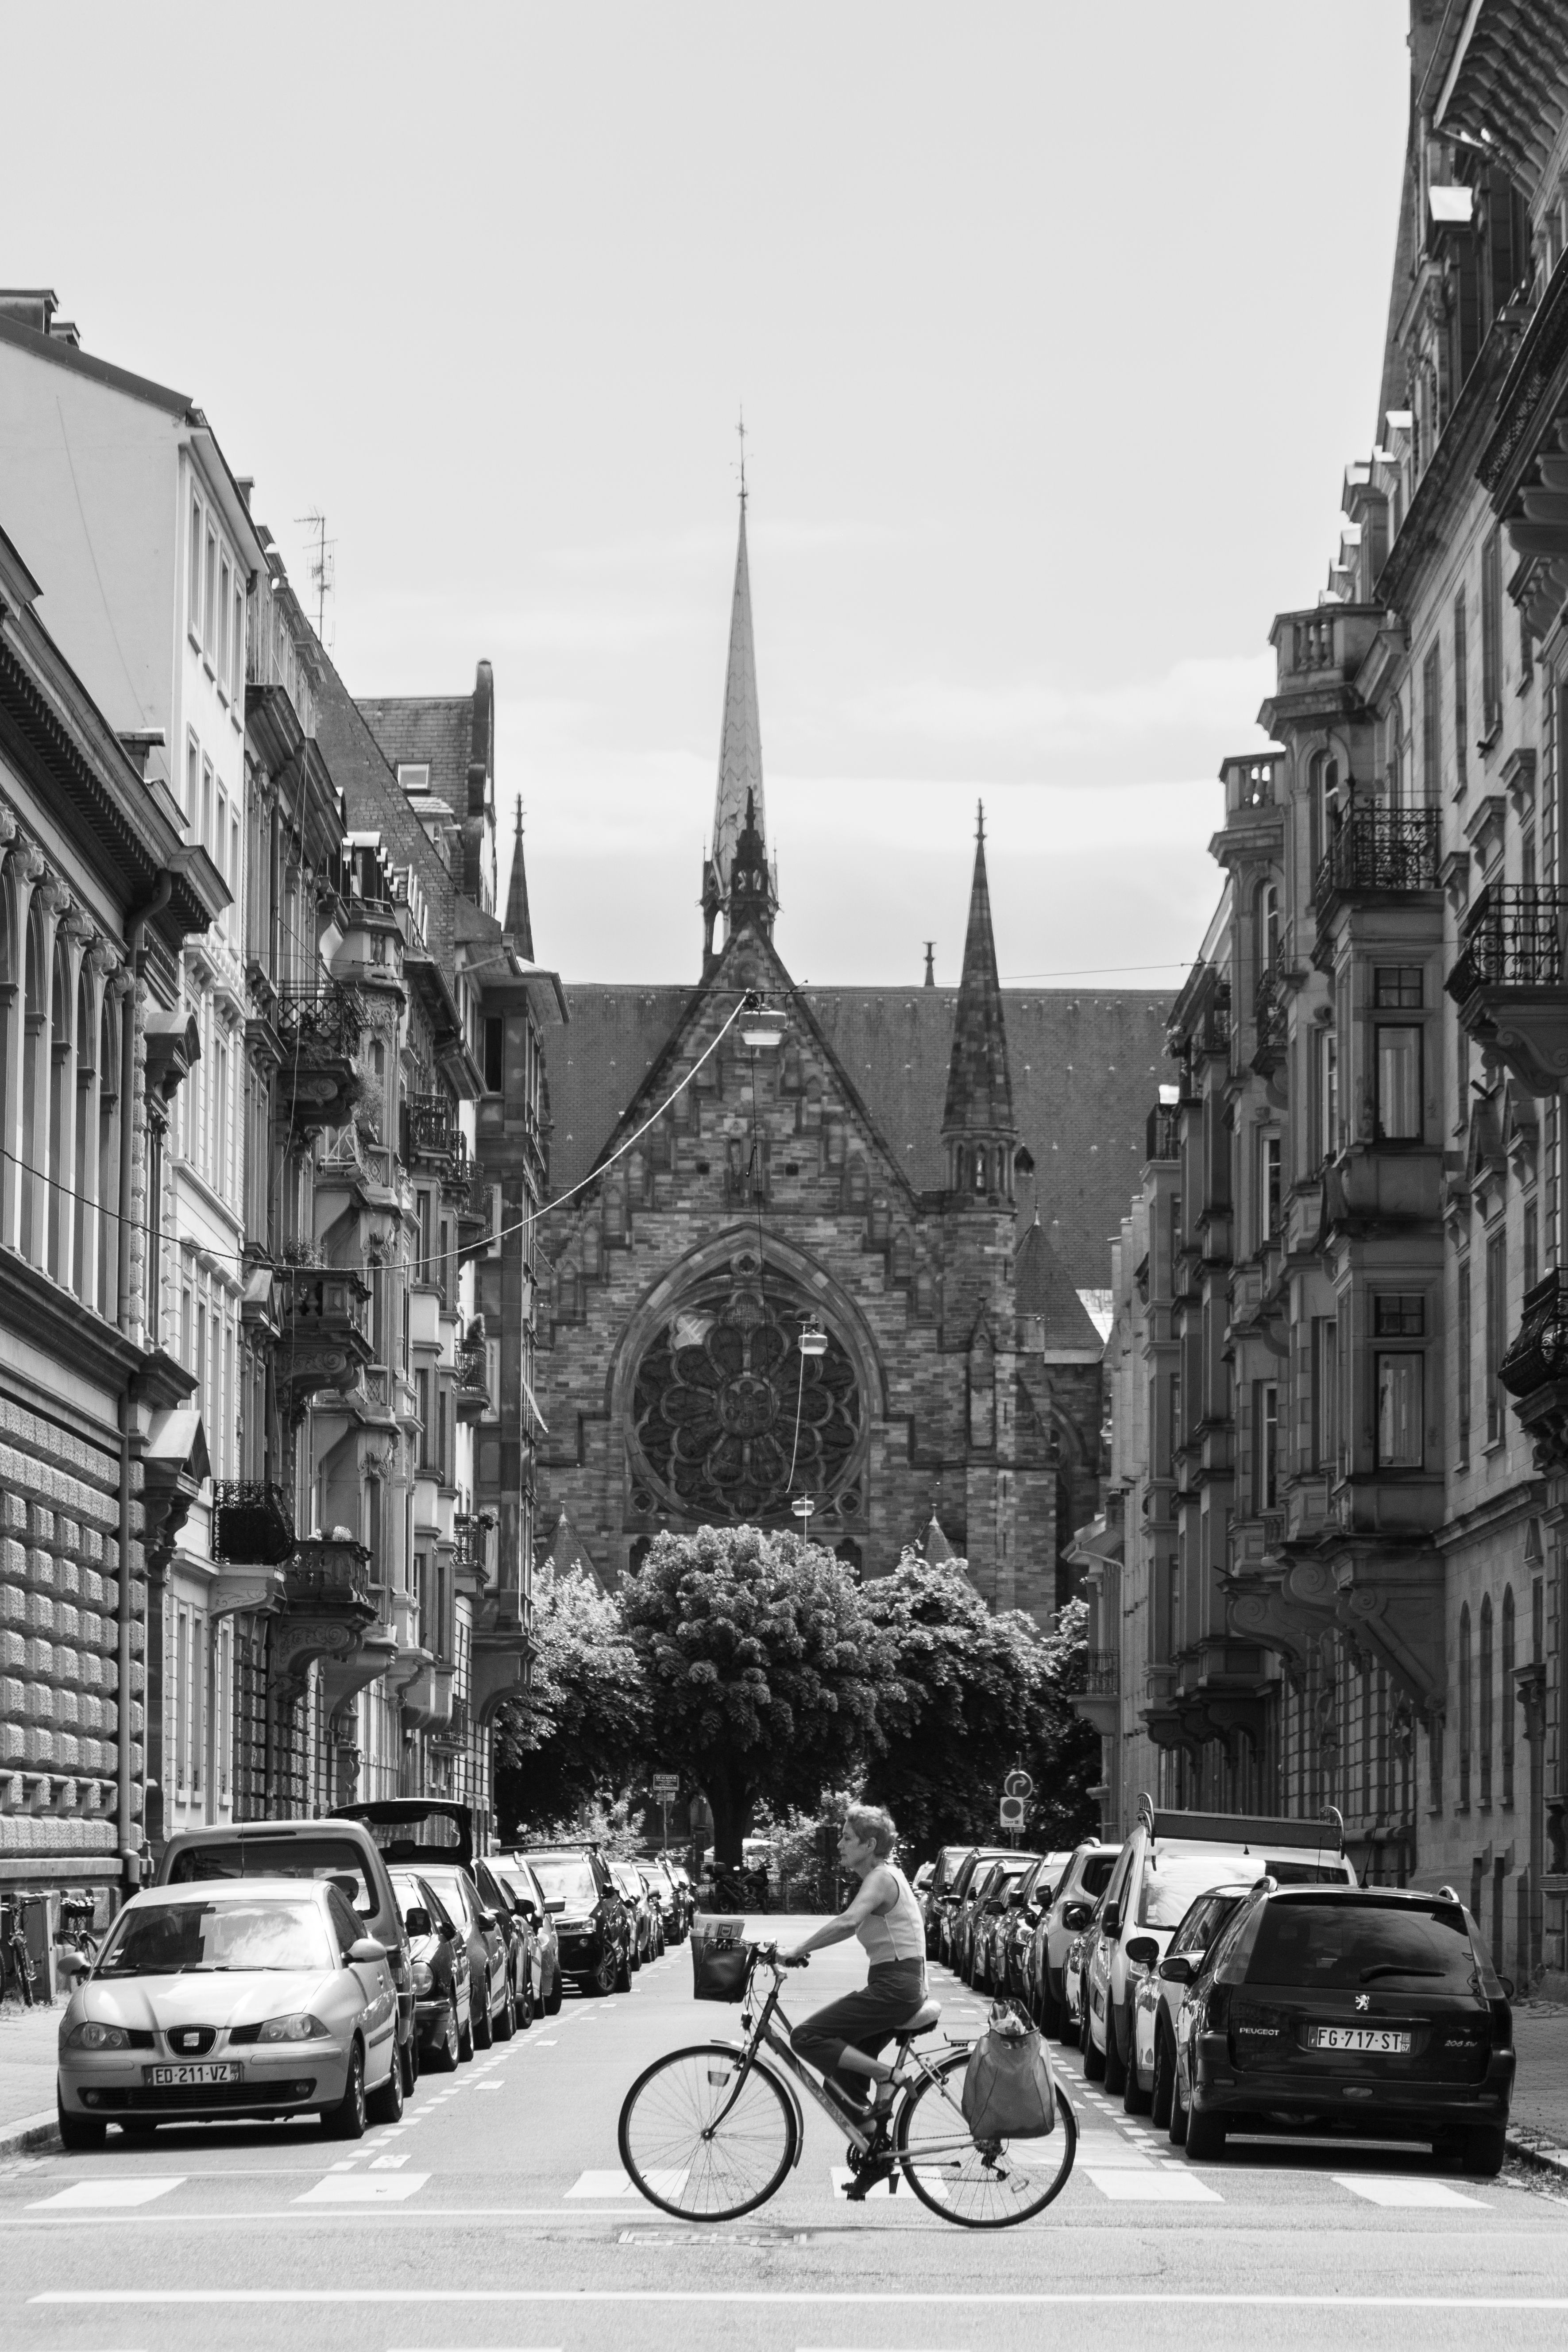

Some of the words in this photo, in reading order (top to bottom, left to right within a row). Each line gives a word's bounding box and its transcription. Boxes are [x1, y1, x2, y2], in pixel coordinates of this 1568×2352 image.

[1240, 2027, 1280, 2036] PEUGEOT
[1318, 2029, 1401, 2051] FG-717-ST
[155, 2066, 228, 2084] ED-211-VZ
